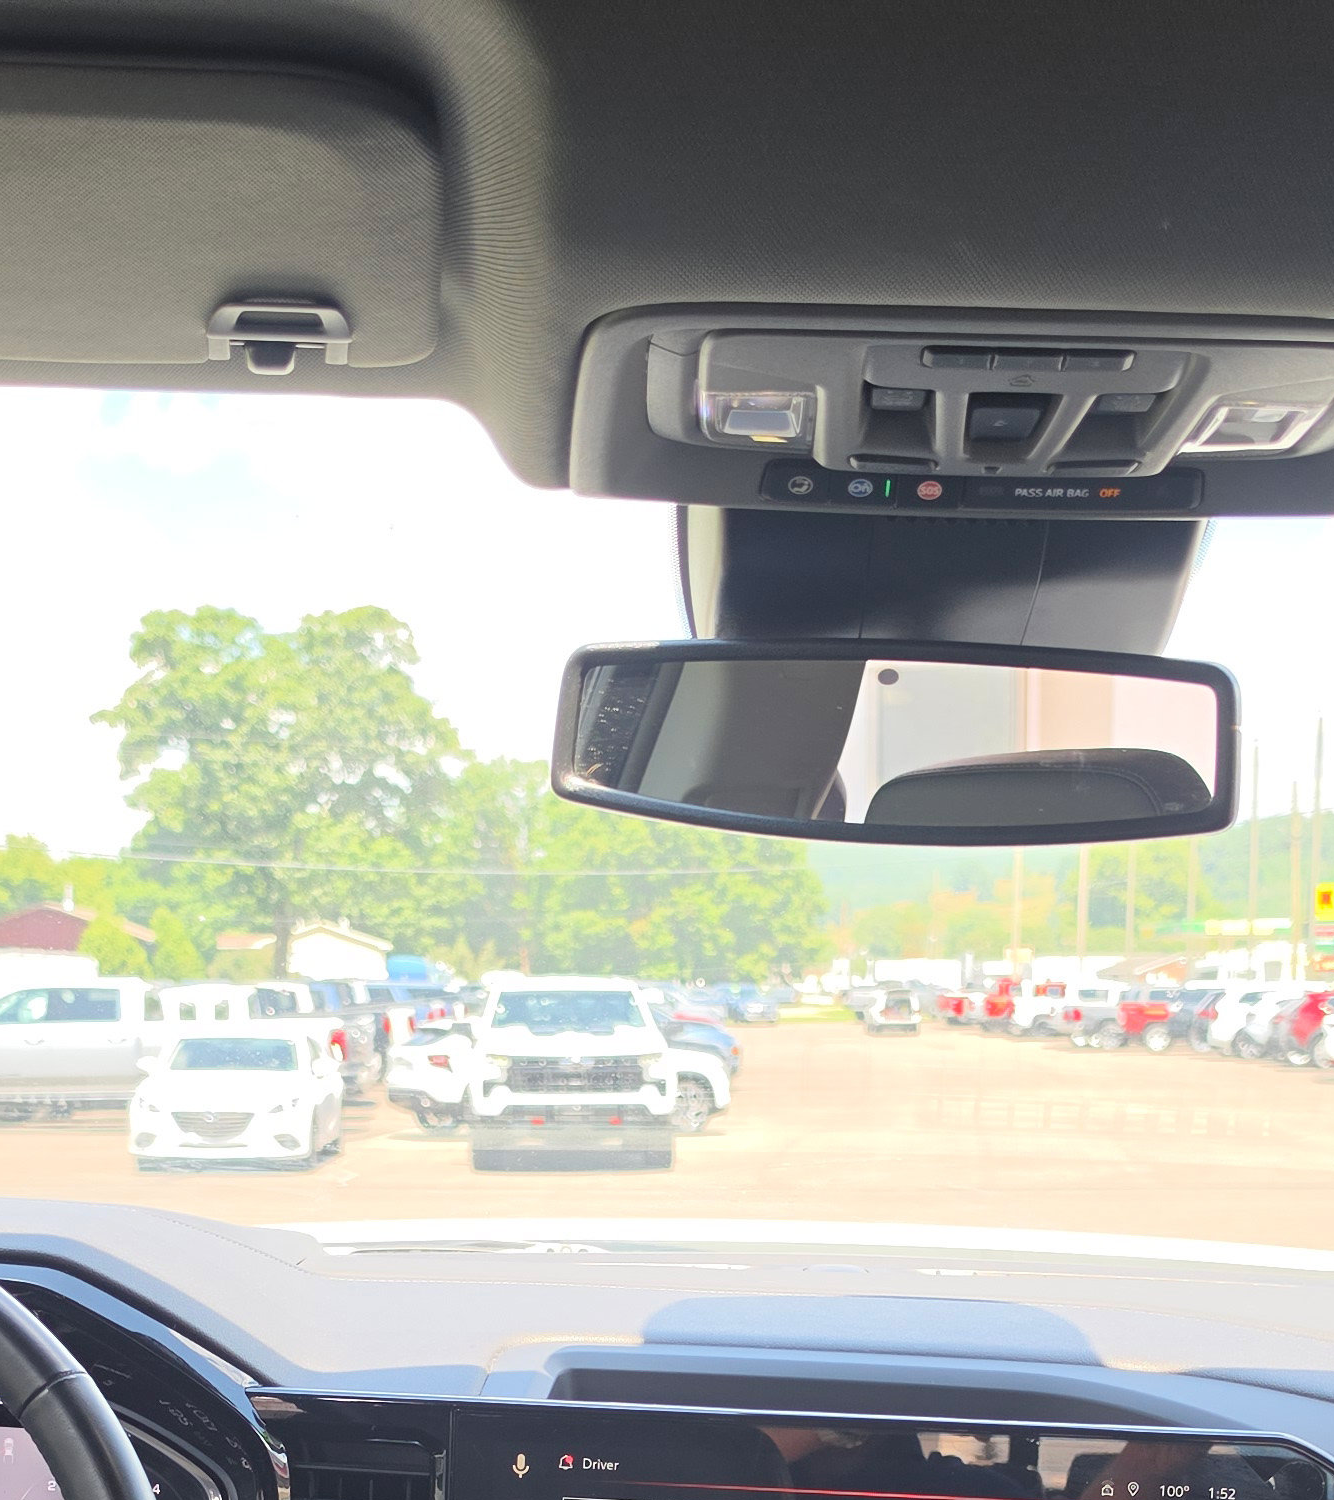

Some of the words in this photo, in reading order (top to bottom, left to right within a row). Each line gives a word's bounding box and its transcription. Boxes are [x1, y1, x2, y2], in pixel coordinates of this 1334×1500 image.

[919, 485, 939, 497] SOS
[1014, 486, 1042, 498] PASS
[1045, 487, 1064, 498] AIR
[1066, 488, 1089, 499] BAG
[1098, 487, 1121, 499] OFF
[582, 1457, 619, 1473] Driver
[1208, 1487, 1236, 1500] 1:52
